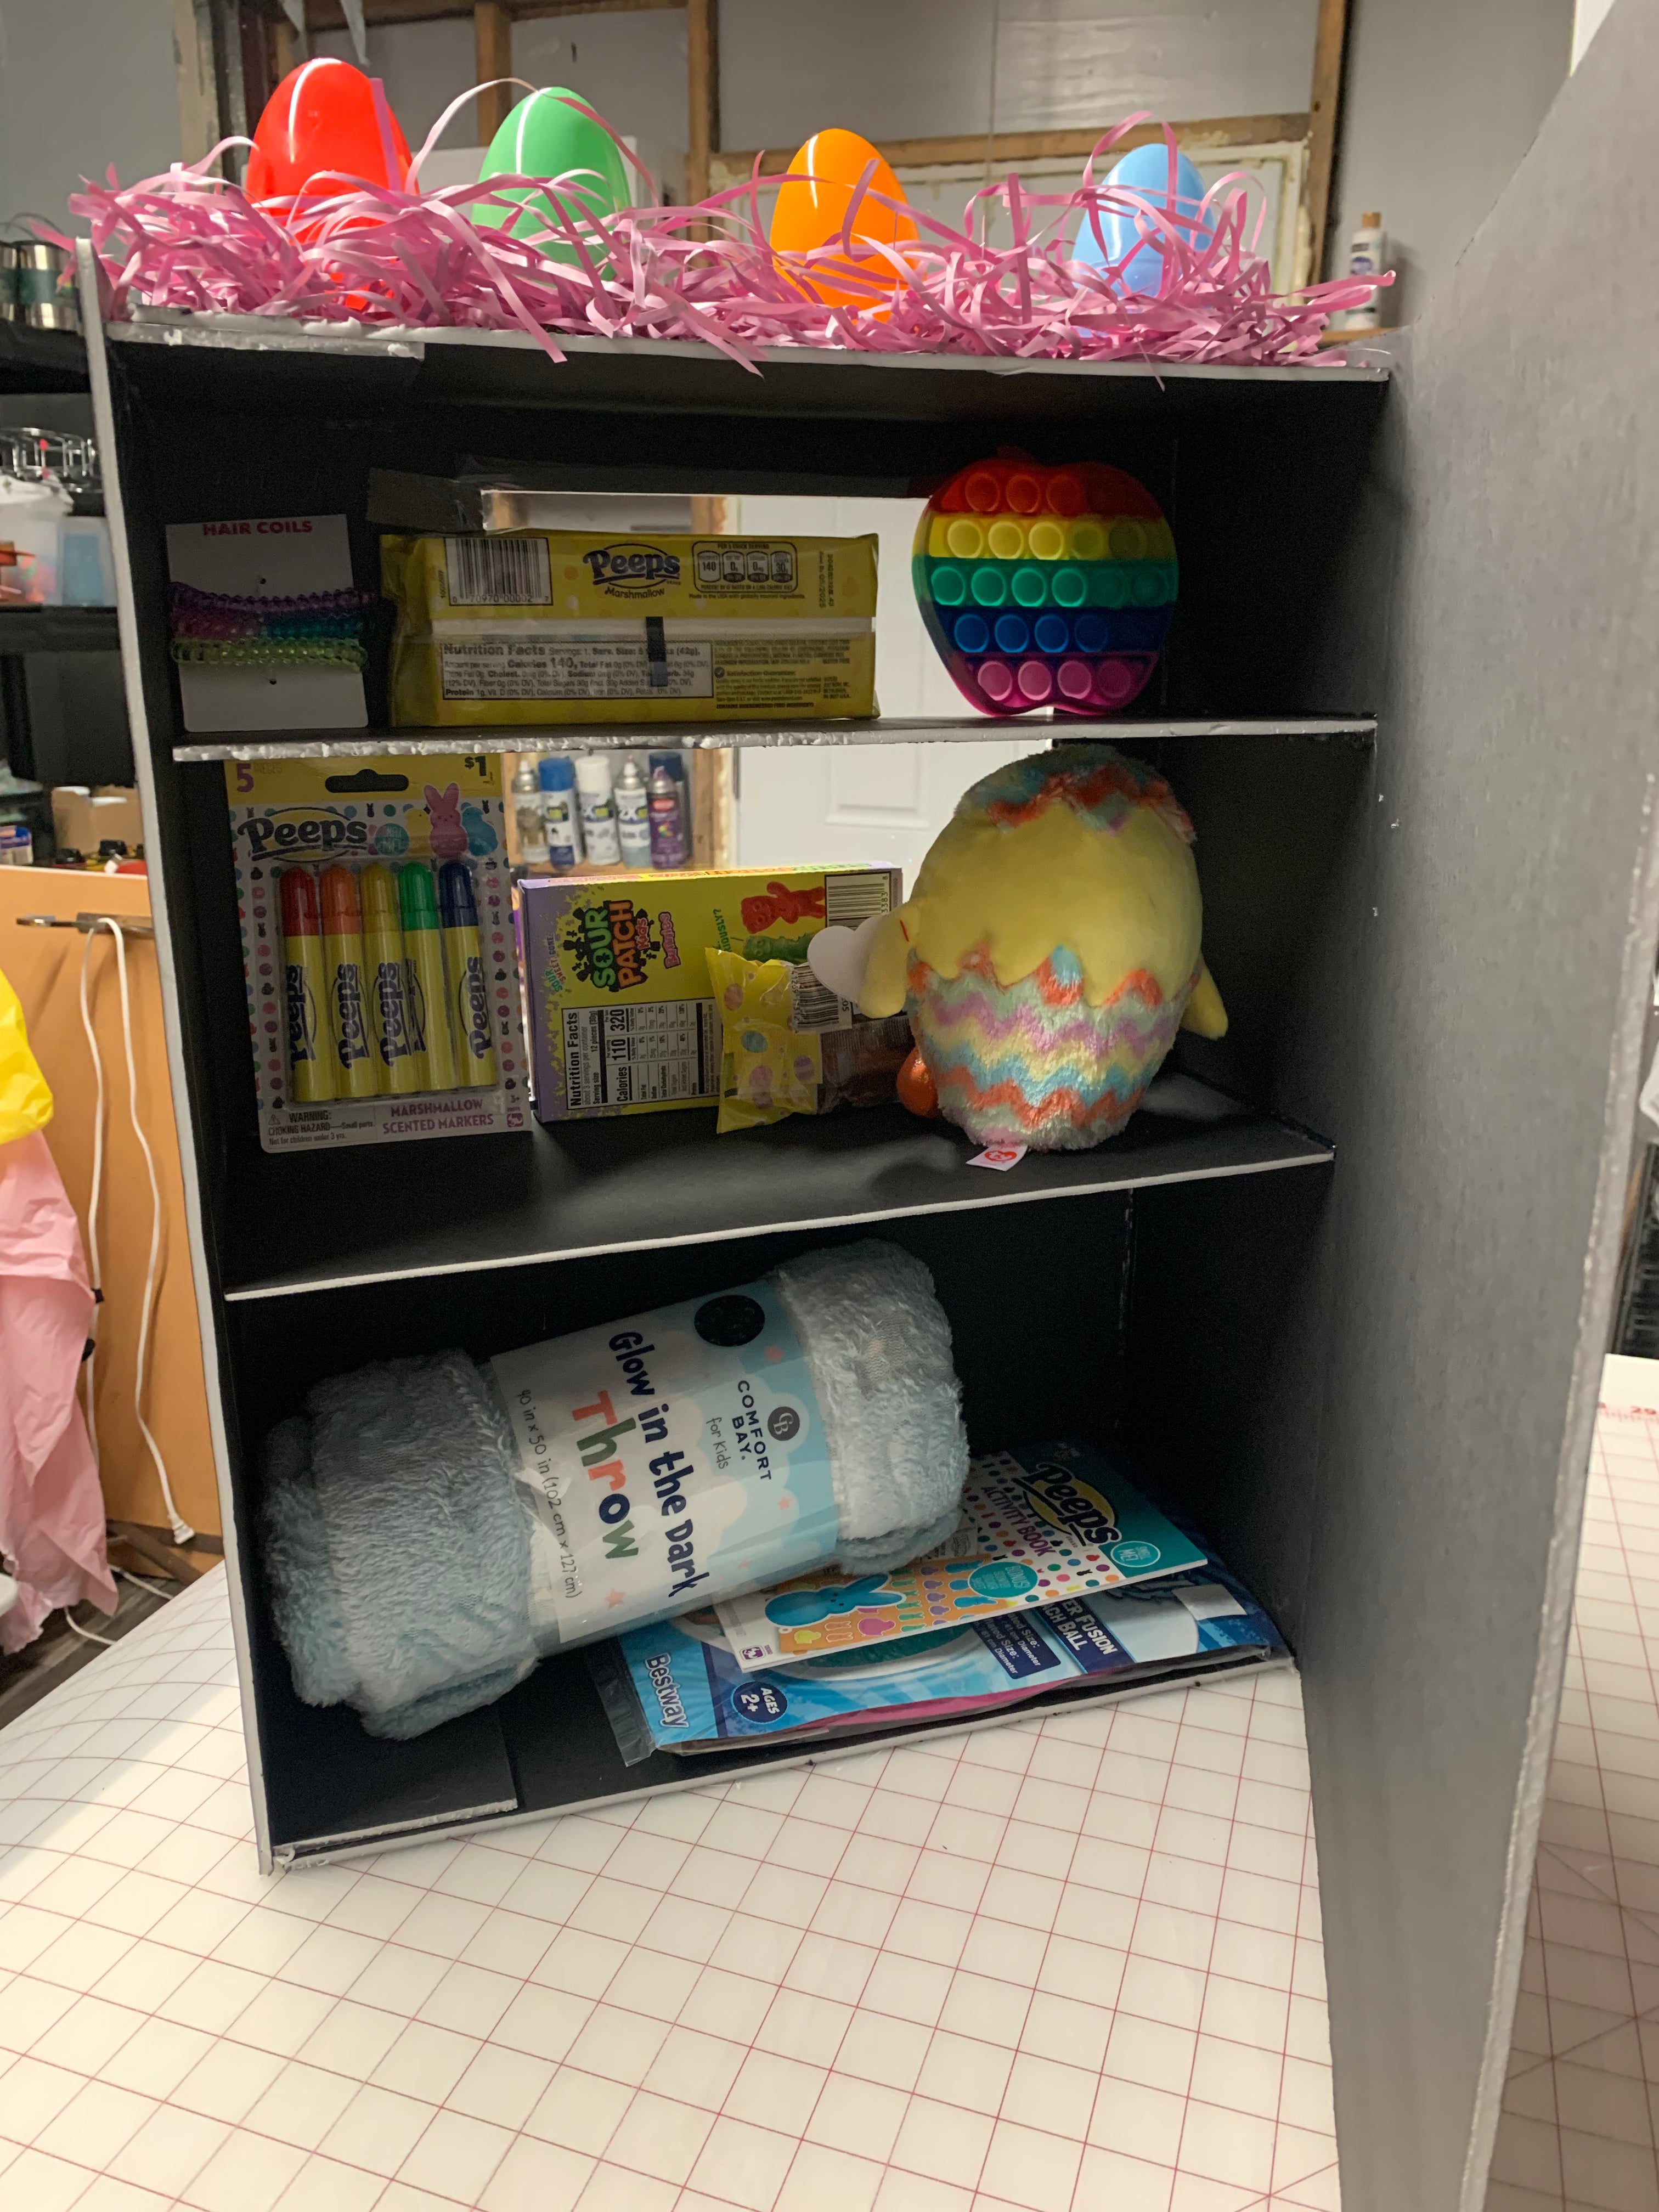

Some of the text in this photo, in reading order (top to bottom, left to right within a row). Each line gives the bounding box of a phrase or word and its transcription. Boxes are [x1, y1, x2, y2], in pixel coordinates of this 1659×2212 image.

[203, 521, 312, 535] HAIR COILS
[583, 550, 680, 580] Peeps
[702, 561, 716, 571] 140
[504, 595, 532, 603] 00002
[605, 586, 665, 599] Marshmallow
[444, 643, 504, 654] Nutrition
[508, 645, 545, 655] Facts
[550, 657, 578, 670] 140,
[464, 755, 487, 776] $1
[236, 763, 255, 793] 5
[237, 817, 368, 854] Peeps
[585, 909, 617, 988] SOUR
[608, 901, 643, 989] PATCH
[337, 963, 368, 1069] Peeps
[379, 962, 409, 1066] Peeps
[590, 1026, 599, 1044] pieces
[566, 1012, 582, 1107] Nutrition Facts
[610, 1009, 628, 1102] Calories 110 320
[583, 1062, 591, 1084] servings
[592, 1084, 601, 1104] Serving
[289, 1110, 332, 1123] WARNING:
[391, 1099, 483, 1117] MARSHMALLOW
[268, 1125, 298, 1136] CHOKING
[382, 1113, 494, 1134] SCENTED MARKERS
[280, 1136, 289, 1144] for
[290, 1135, 312, 1143] children
[336, 1132, 347, 1141] yrs.
[522, 1406, 536, 1421] in
[737, 1380, 771, 1481] COMFORT
[528, 1434, 547, 1455] 50
[705, 1417, 731, 1469] for Kids
[538, 1458, 551, 1474] in
[571, 1390, 639, 1559] Throw
[608, 1331, 710, 1599] Glow in the Dark
[541, 1476, 561, 1509] (102
[1020, 1463, 1119, 1545] Peeps
[555, 1513, 566, 1536] cm
[981, 1486, 1029, 1526] ACTIVITY
[1017, 1526, 1056, 1557] BOOK
[560, 1554, 577, 1572] 127
[565, 1577, 583, 1598] cm)
[1021, 1628, 1040, 1648] Size:
[1057, 1621, 1088, 1651] BALL
[1074, 1614, 1118, 1655] FUSION
[1001, 1639, 1020, 1659] Size:
[1017, 1640, 1041, 1666] Diameter
[994, 1647, 1018, 1674] Diameter
[646, 1654, 688, 1728] Bestway
[760, 1687, 780, 1714] AGES
[740, 1694, 760, 1713] 2+
